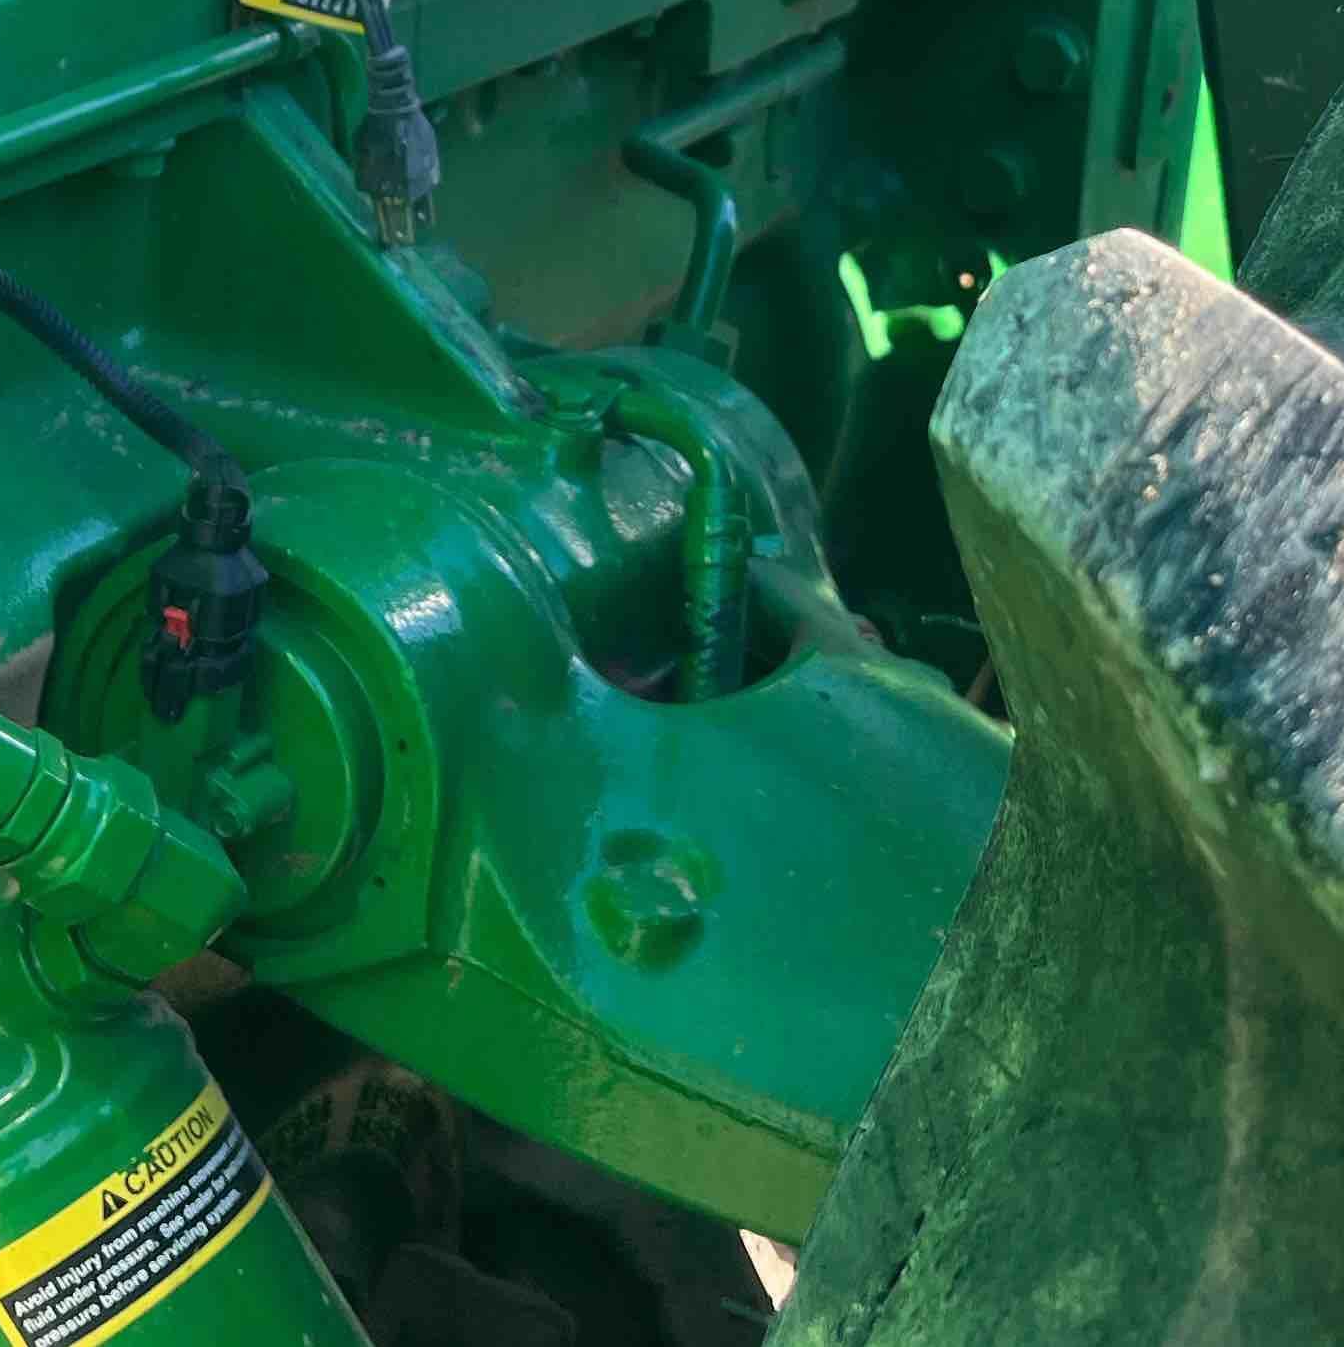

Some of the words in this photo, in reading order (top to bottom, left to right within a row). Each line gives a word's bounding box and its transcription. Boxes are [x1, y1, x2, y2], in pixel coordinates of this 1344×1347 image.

[124, 1106, 215, 1195] CAUTION
[14, 1281, 59, 1318] Avoid
[56, 1253, 102, 1290] injury
[101, 1227, 138, 1259] from
[137, 1184, 191, 1233] machine
[22, 1305, 57, 1334] fluid
[56, 1280, 97, 1314] under
[159, 1215, 185, 1239] See
[34, 1303, 101, 1347] pressure
[99, 1268, 150, 1309] before
[148, 1221, 208, 1274] servicing
